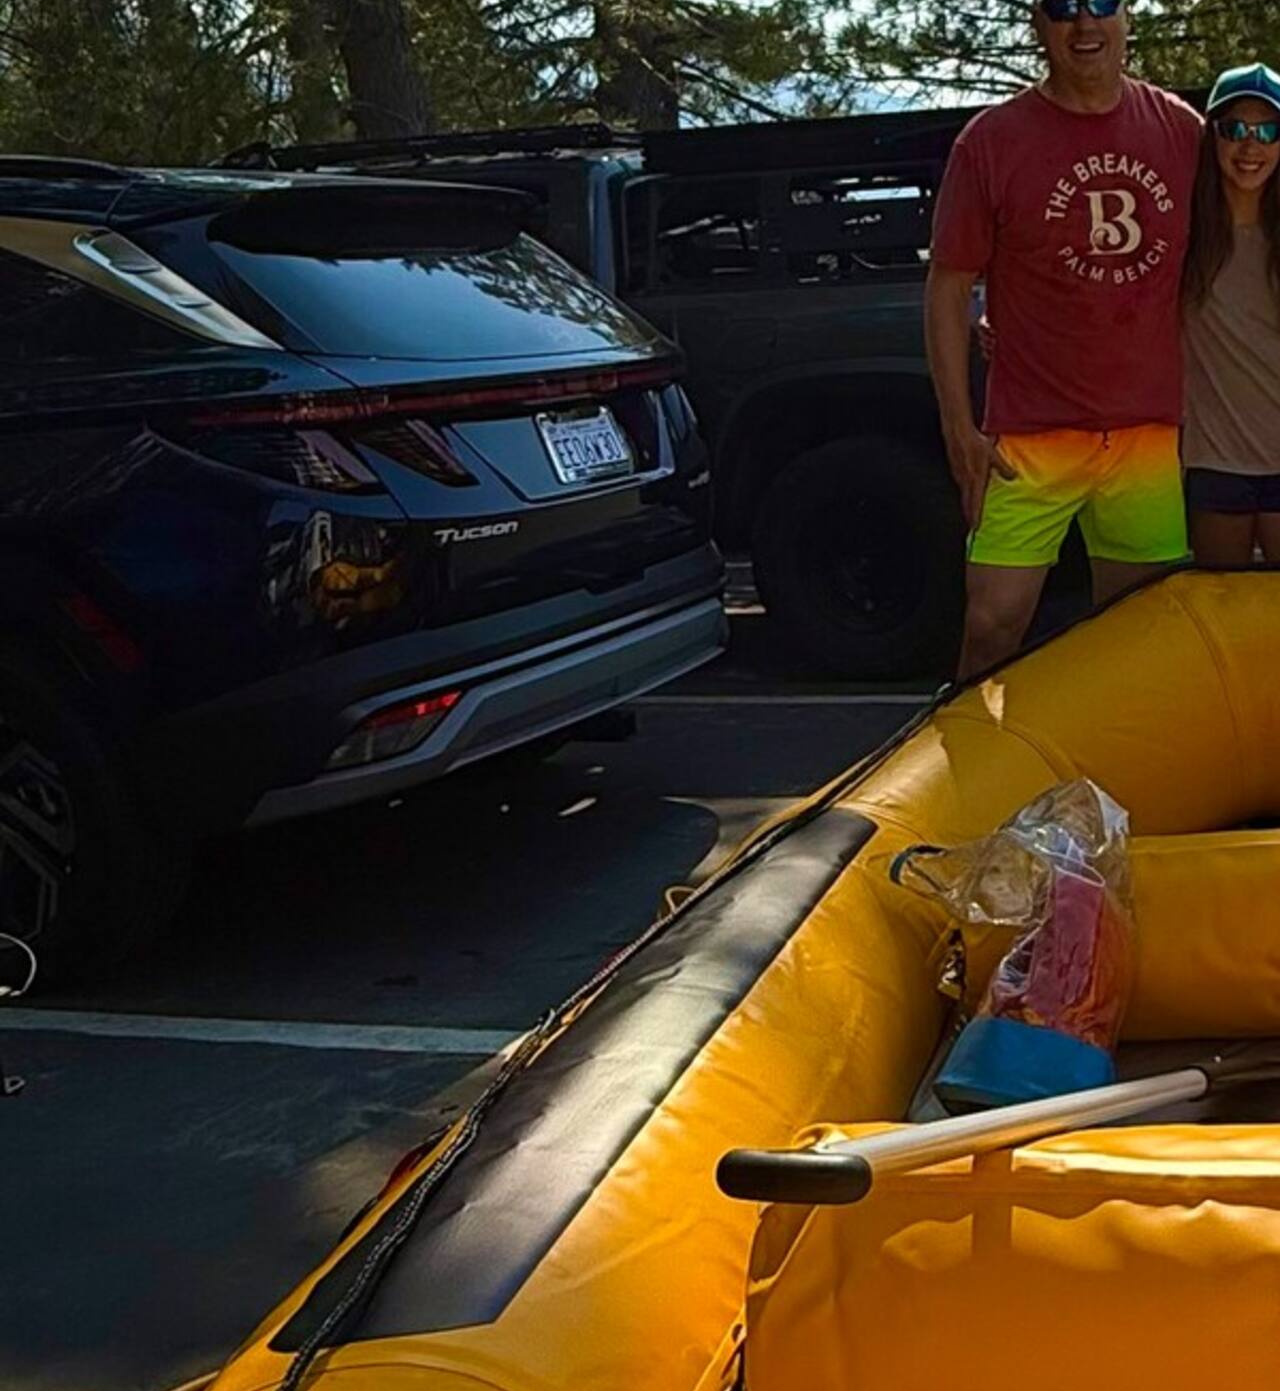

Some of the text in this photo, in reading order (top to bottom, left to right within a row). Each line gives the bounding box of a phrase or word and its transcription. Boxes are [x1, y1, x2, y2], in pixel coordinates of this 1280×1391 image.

[1044, 153, 1175, 221] THE BREAKERS
[1083, 189, 1142, 256] B
[1058, 238, 1169, 284] PALM BEACH
